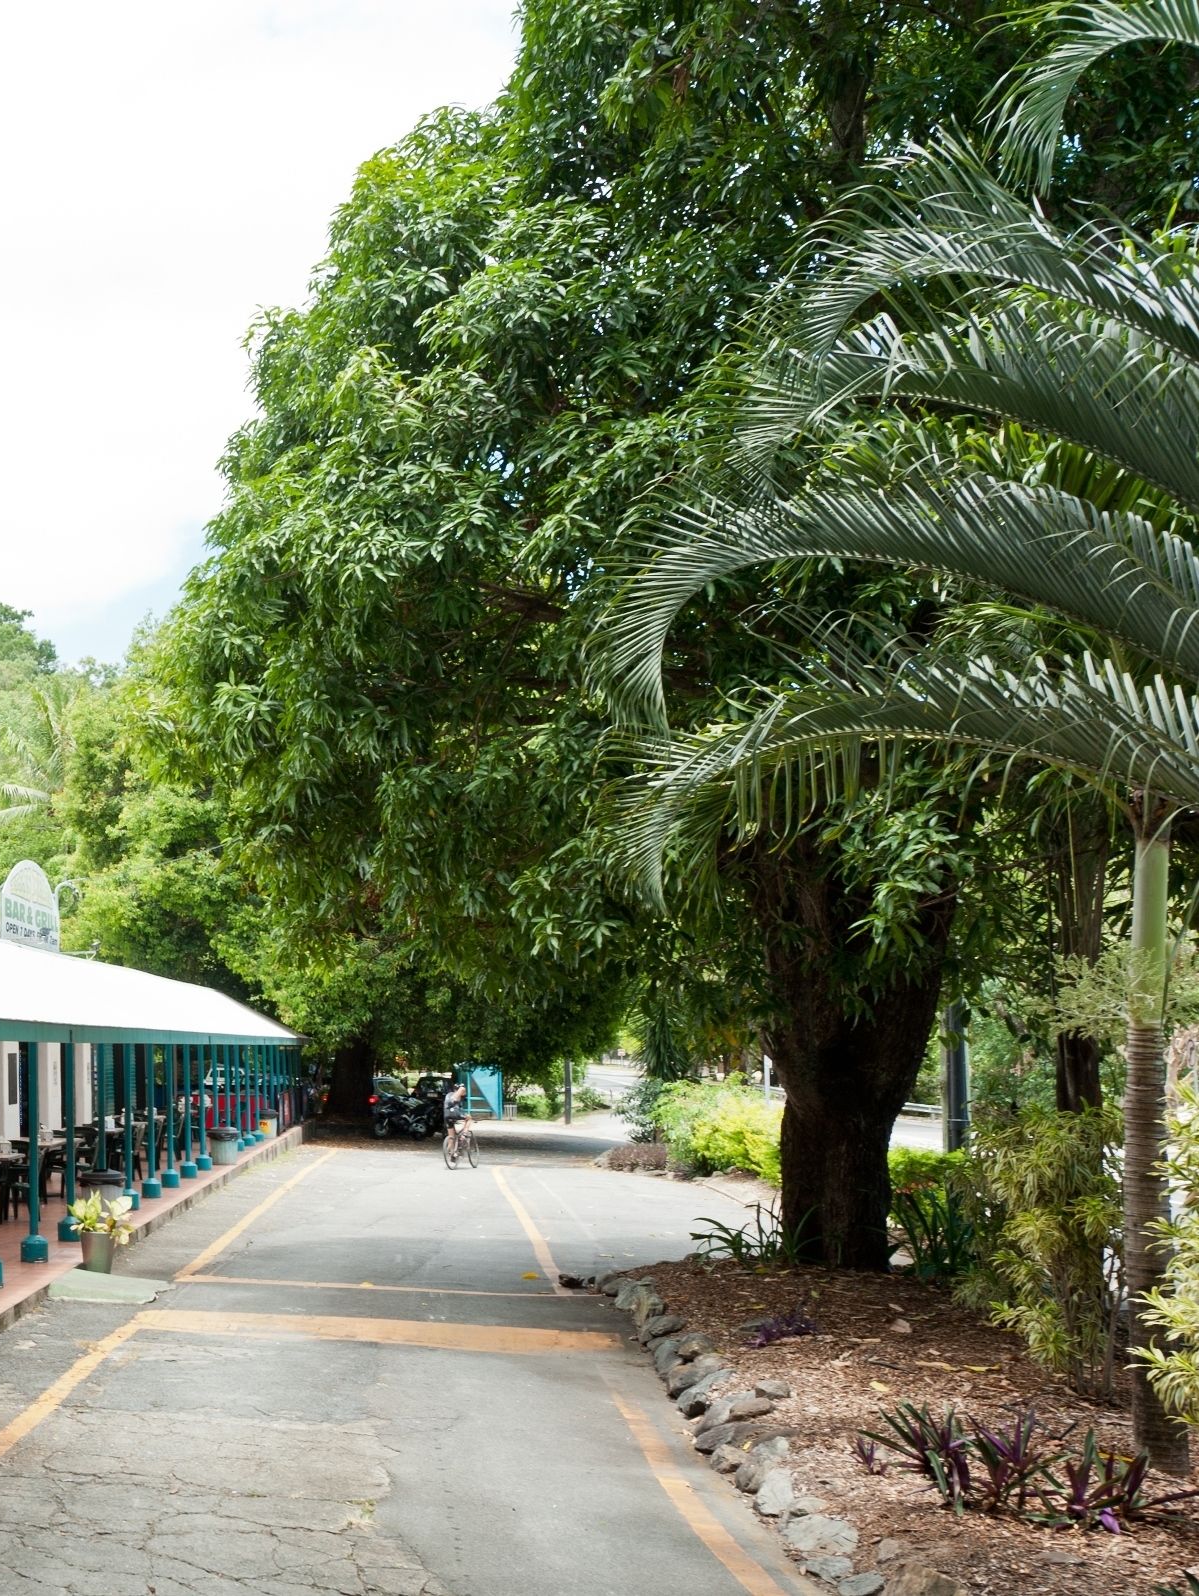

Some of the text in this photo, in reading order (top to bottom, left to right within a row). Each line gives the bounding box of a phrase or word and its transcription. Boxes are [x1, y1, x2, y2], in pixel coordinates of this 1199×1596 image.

[4, 897, 58, 933] BAR & GRILL
[5, 921, 19, 935] OPEN
